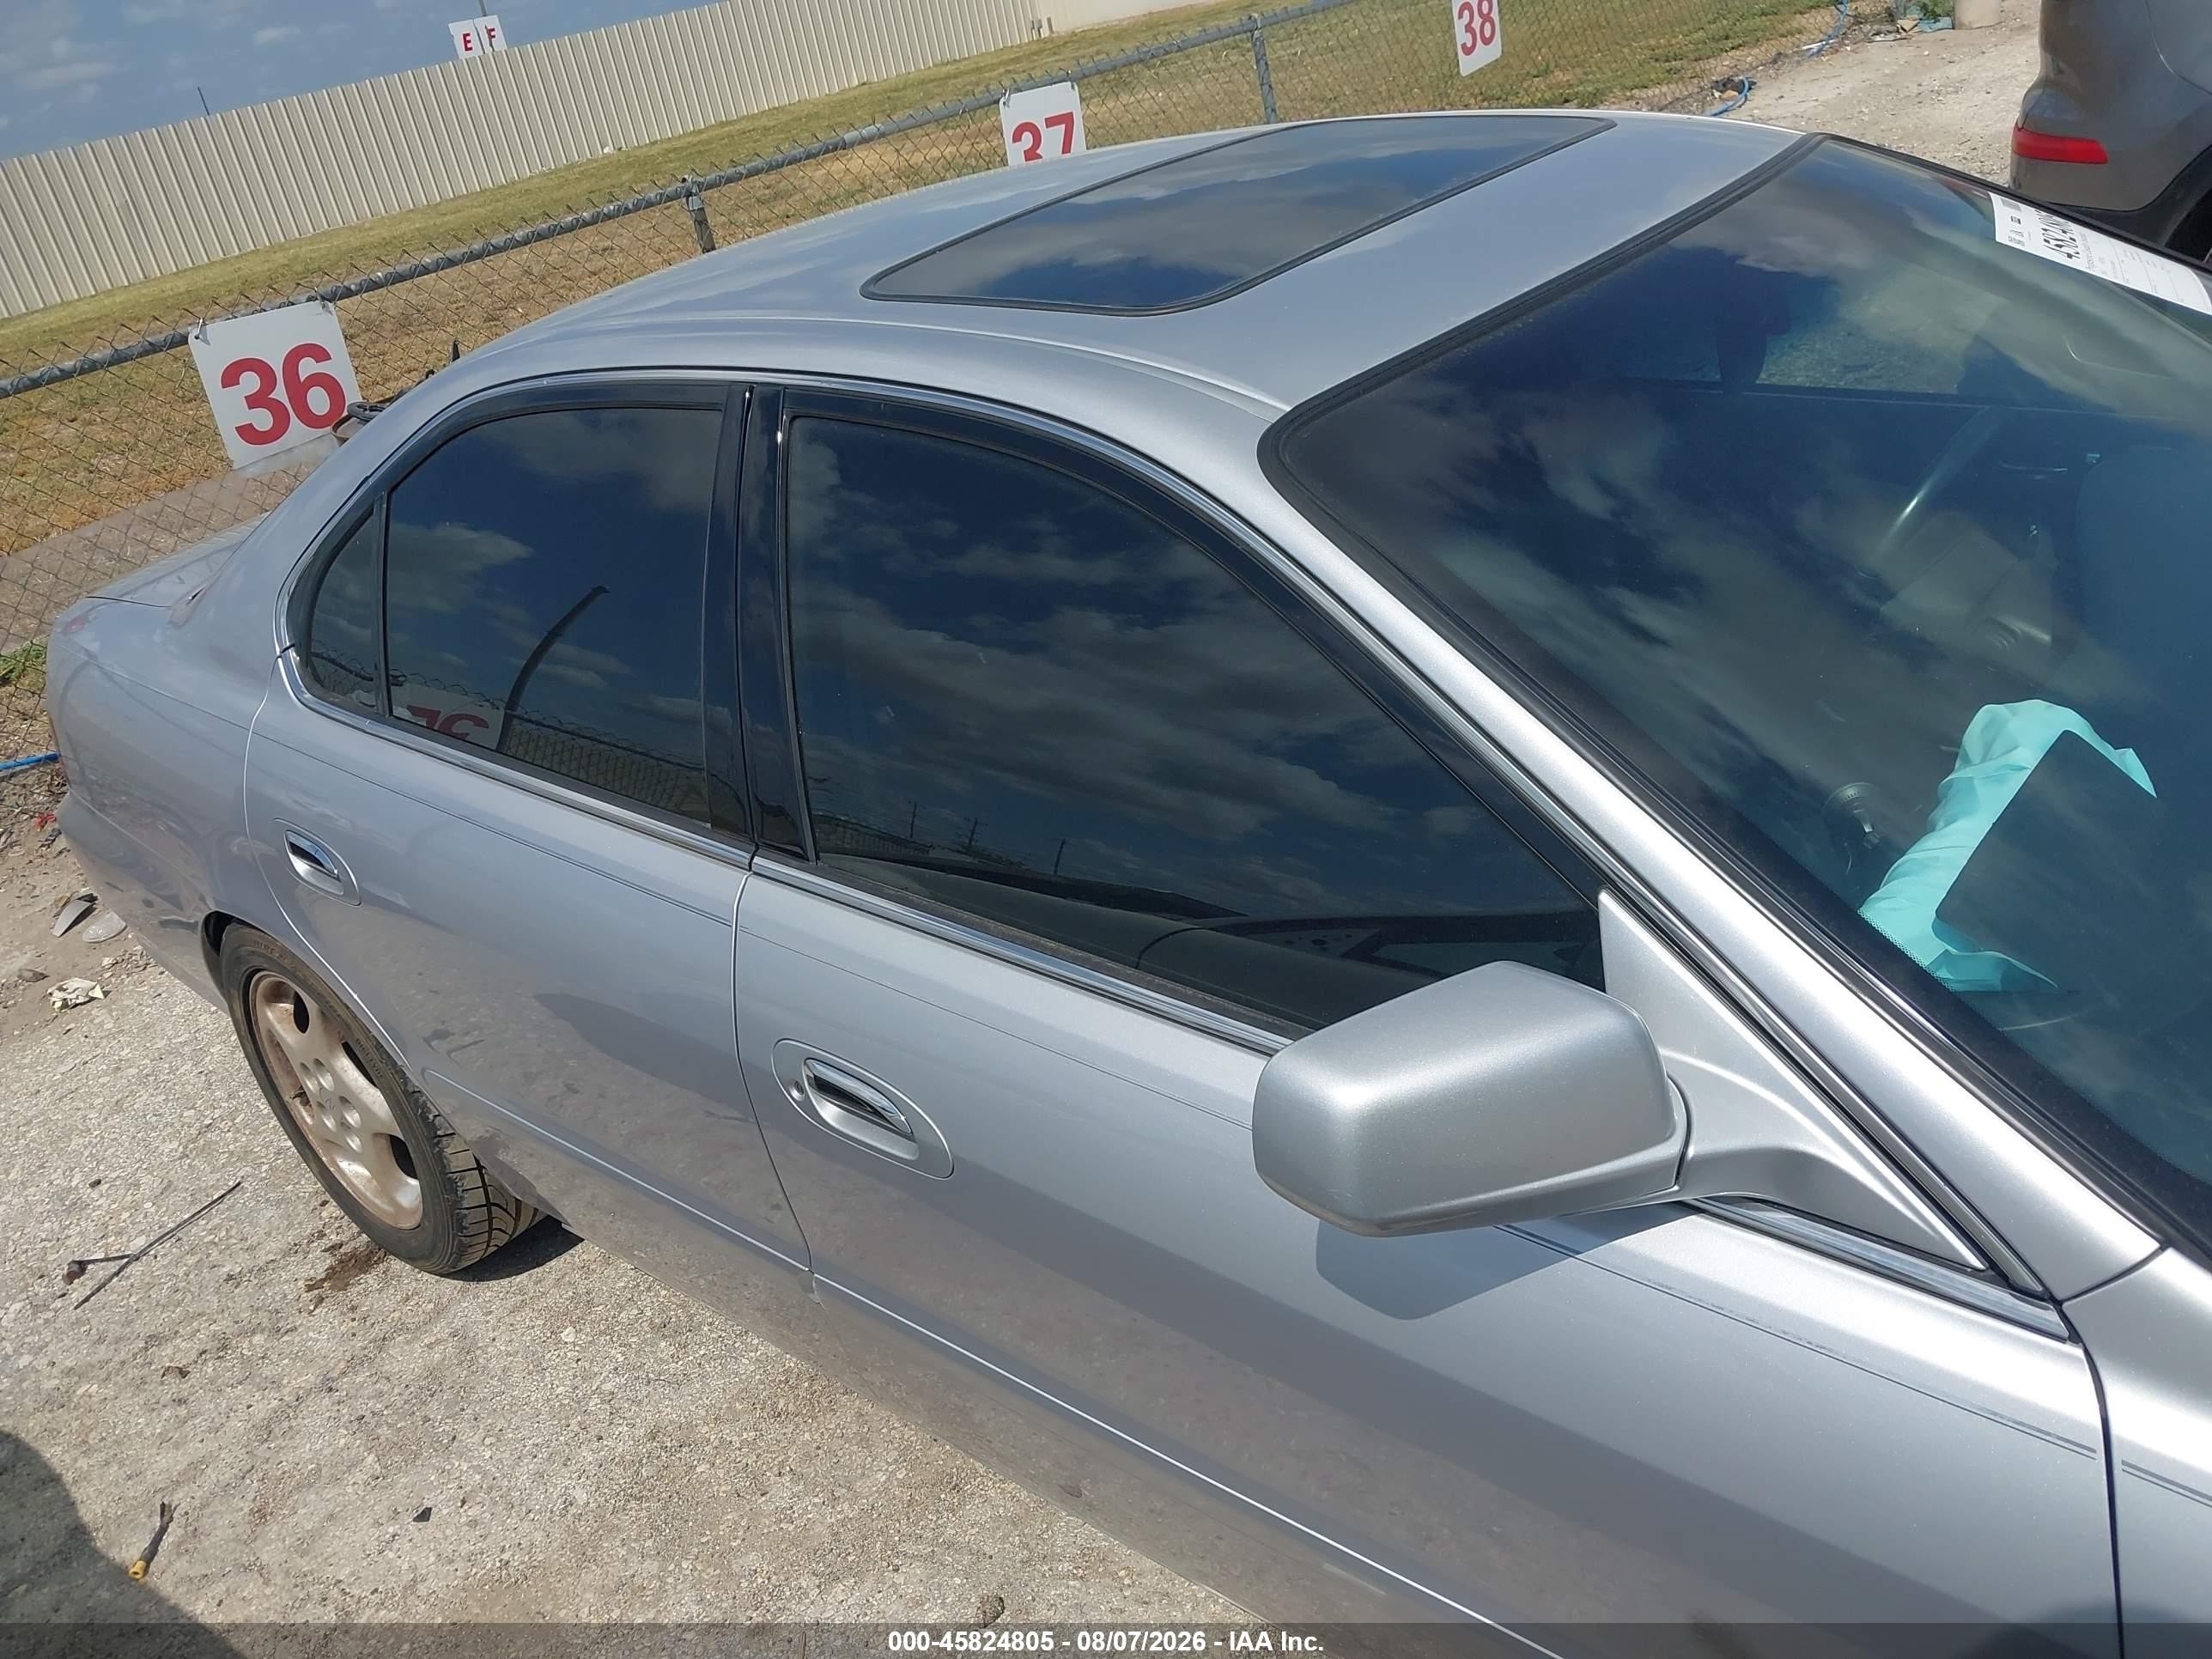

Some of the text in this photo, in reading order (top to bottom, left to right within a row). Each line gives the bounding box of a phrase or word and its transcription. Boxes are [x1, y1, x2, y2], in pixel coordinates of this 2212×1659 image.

[462, 33, 473, 52] E
[486, 27, 496, 47] F
[1457, 0, 1496, 57] 38
[1012, 111, 1075, 162] 37
[221, 343, 346, 446] 36
